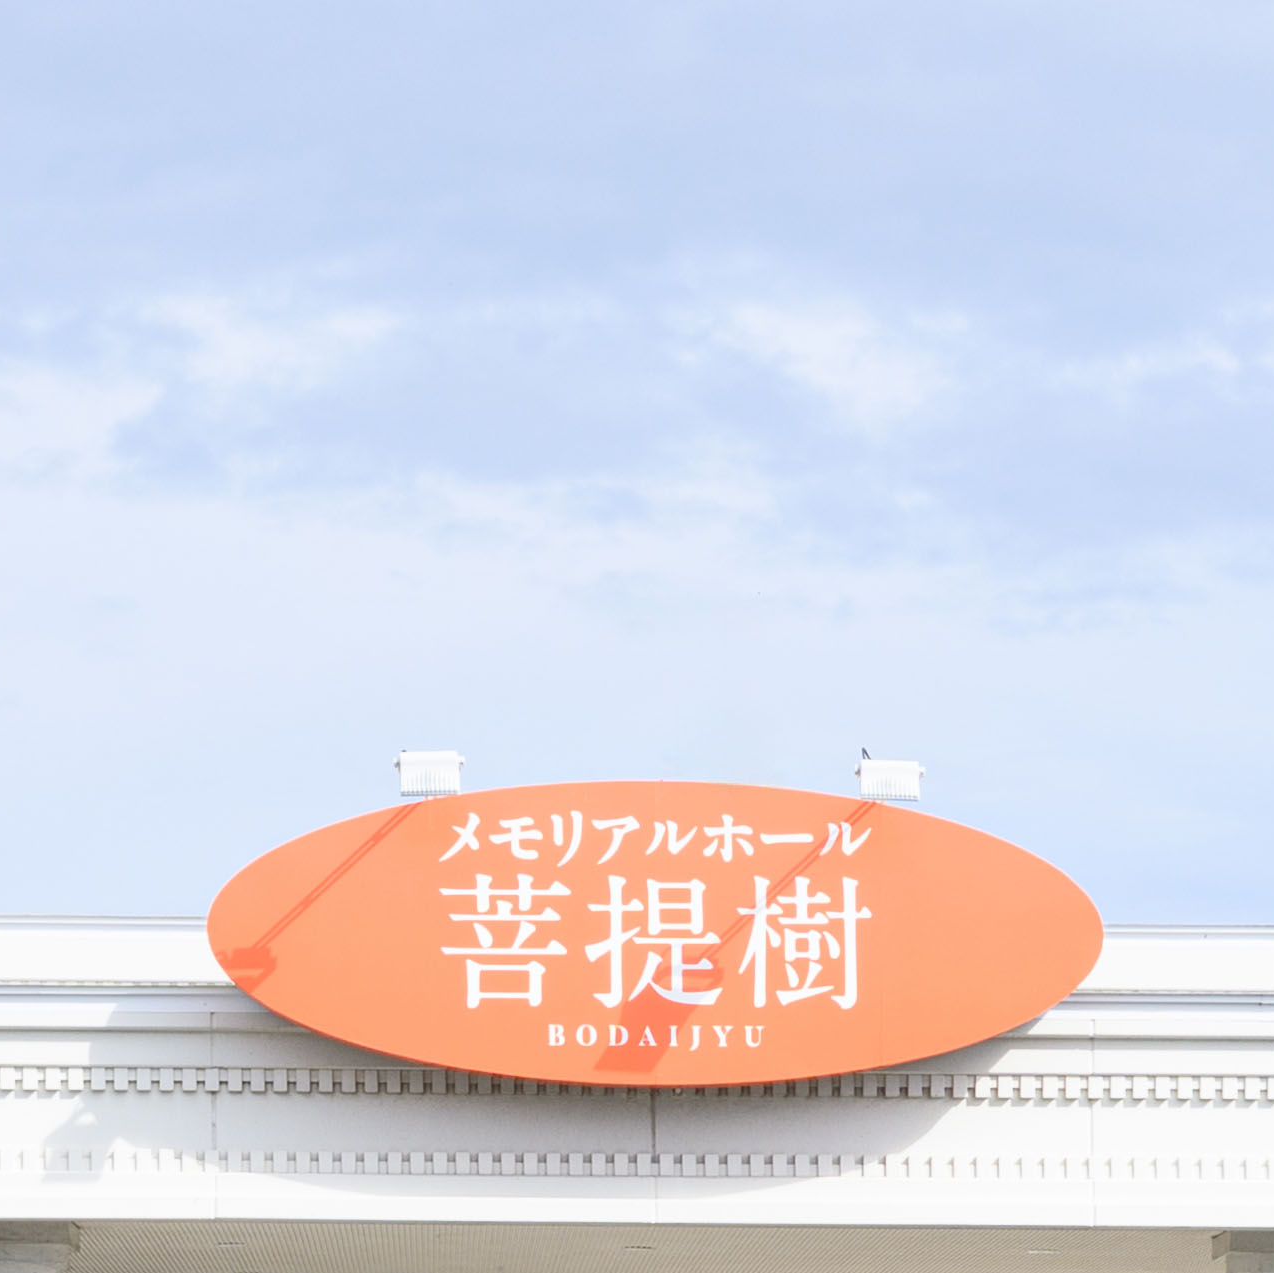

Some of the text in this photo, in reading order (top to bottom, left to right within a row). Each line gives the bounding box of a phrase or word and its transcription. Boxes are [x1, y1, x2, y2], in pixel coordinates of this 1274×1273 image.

[438, 809, 873, 868] メモリアルホール
[438, 873, 873, 1010] 菩提樹
[547, 1023, 767, 1049] BODAIJYU
